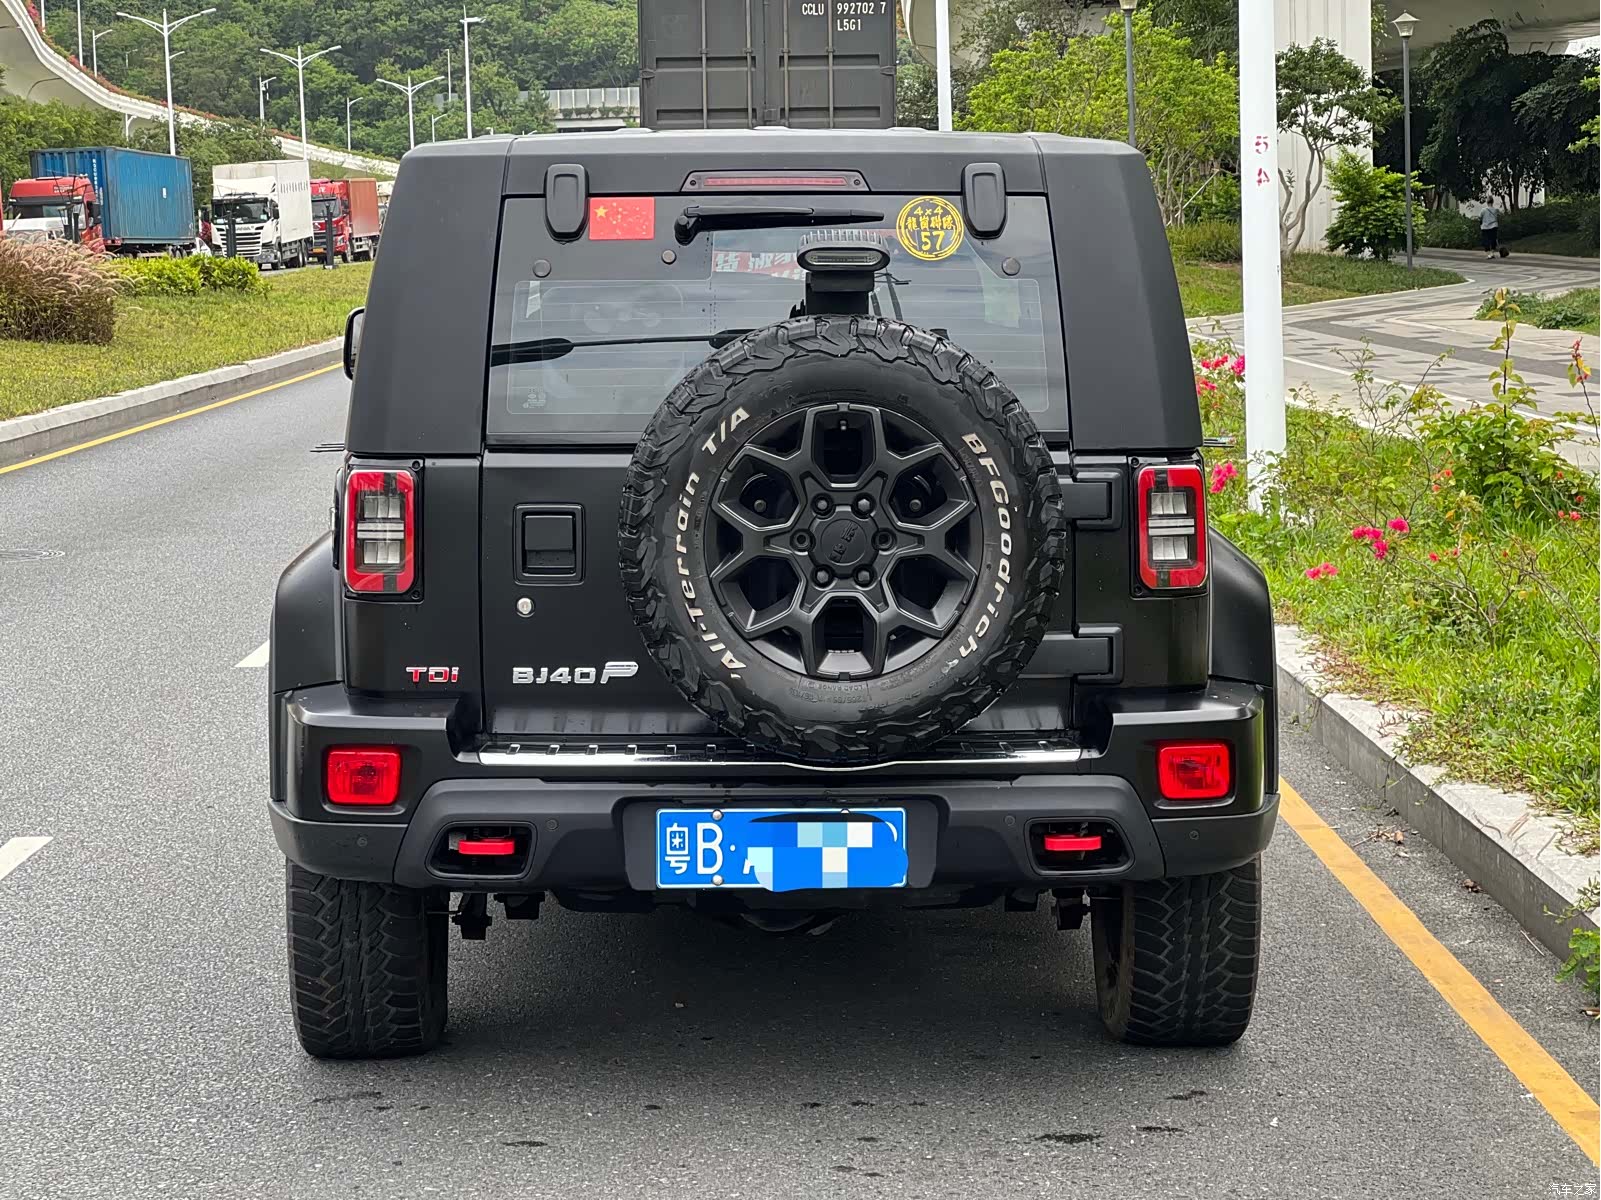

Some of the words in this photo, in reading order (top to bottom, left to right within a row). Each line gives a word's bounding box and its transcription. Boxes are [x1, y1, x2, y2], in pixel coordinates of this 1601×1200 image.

[801, 3, 825, 15] CCLU
[836, 2, 875, 15] 992702
[879, 2, 887, 14] 7
[837, 18, 862, 31] L5G1
[920, 230, 945, 251] 57
[701, 406, 751, 456] T/A
[961, 432, 1013, 659] BFGoodrich
[675, 471, 747, 670] All-Terrain
